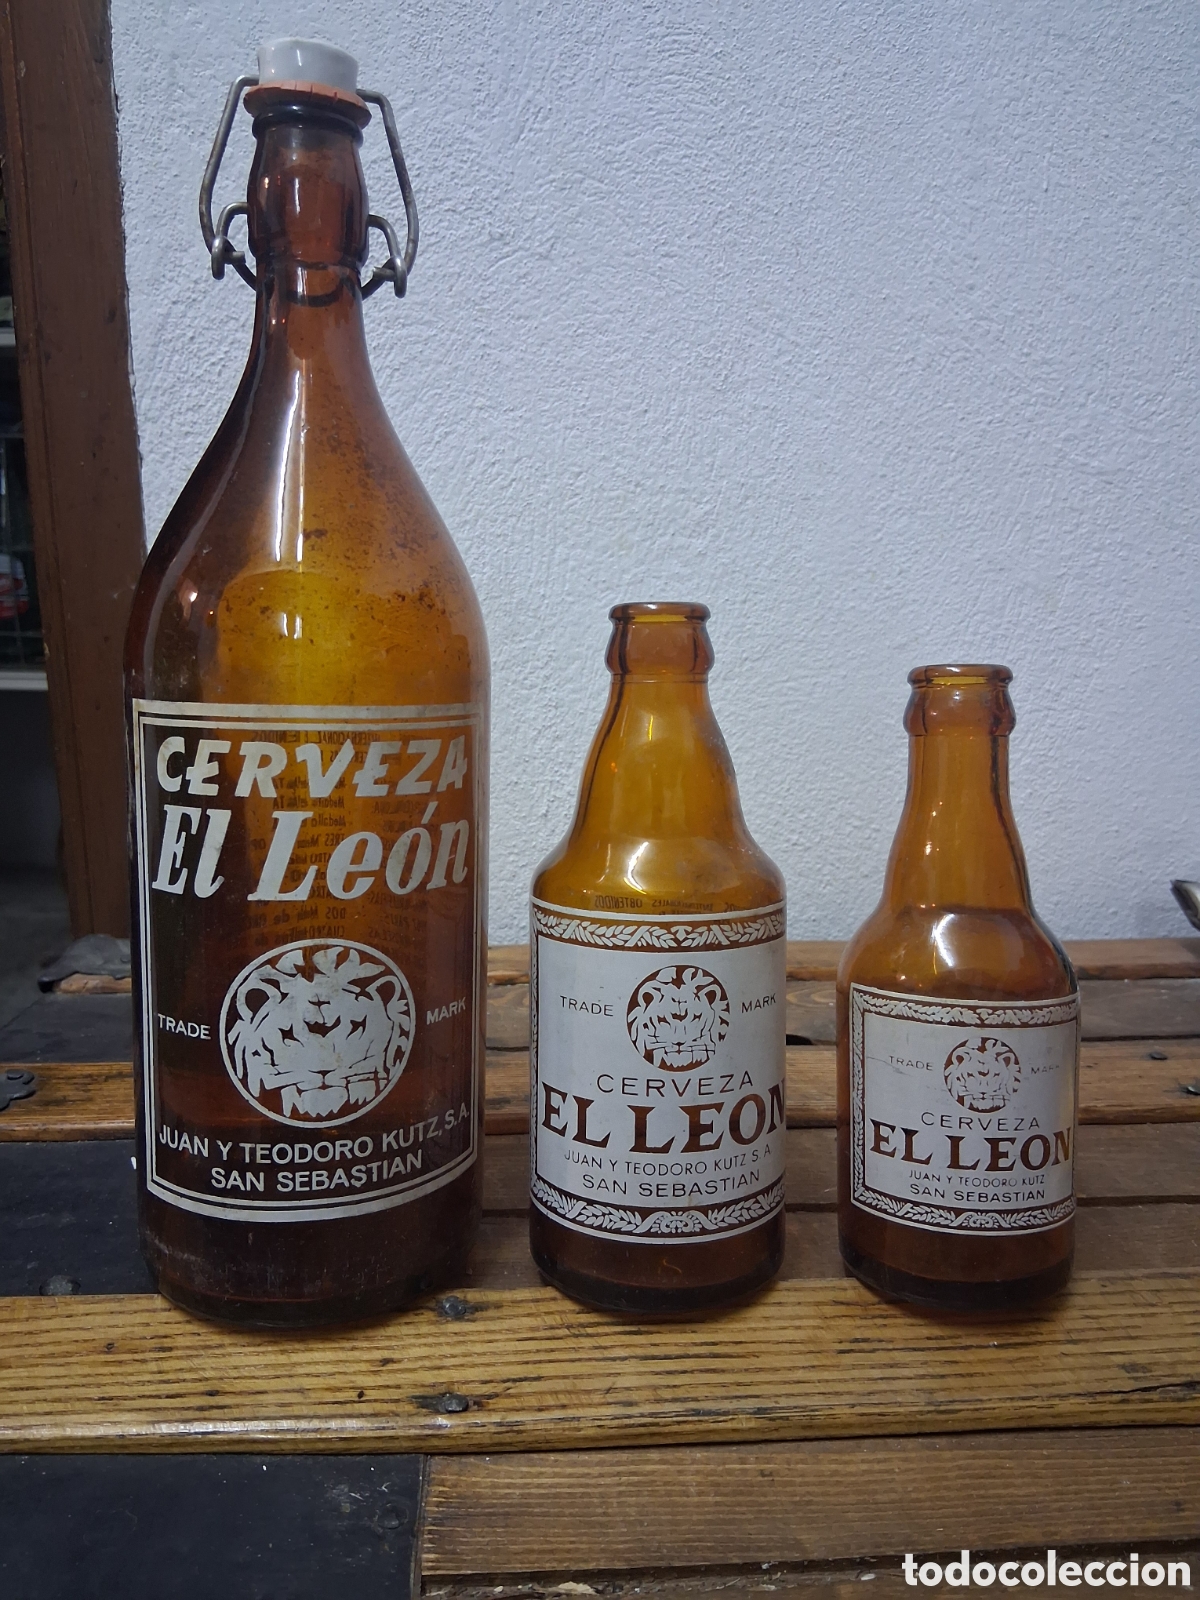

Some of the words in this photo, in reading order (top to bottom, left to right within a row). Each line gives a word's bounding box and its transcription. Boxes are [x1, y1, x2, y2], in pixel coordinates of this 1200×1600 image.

[157, 735, 468, 798] CERVEZA
[151, 804, 232, 898] El
[247, 802, 470, 901] León
[157, 1013, 211, 1041] TRADE
[425, 996, 467, 1026] MARK
[560, 995, 614, 1017] TRADE
[741, 993, 776, 1014] MARK
[888, 1055, 933, 1071] TRADE
[596, 1070, 754, 1098] CERVEZA
[541, 1081, 611, 1149] EL
[626, 1077, 785, 1154] LEON
[920, 1111, 1040, 1131] CERVEZA
[159, 1125, 209, 1158] JUAN
[216, 1140, 233, 1161] Y
[240, 1136, 374, 1165] TEODORO
[869, 1118, 933, 1166] EL
[944, 1126, 1072, 1172] LEON
[211, 1168, 265, 1192] SAN
[276, 1149, 423, 1192] SEBASTIAN
[564, 1149, 602, 1169] JUAN
[609, 1160, 618, 1172] Y
[625, 1161, 707, 1177] TEODORO
[714, 1153, 747, 1172] KUTZ
[582, 1174, 627, 1196] SAN
[639, 1169, 760, 1198] SEBASTIAN
[909, 1169, 941, 1183] JUAN
[946, 1176, 953, 1184] Y
[959, 1176, 1018, 1188] TEODORO
[1022, 1174, 1045, 1185] KUTZ
[910, 1184, 945, 1199] SAN
[953, 1189, 1045, 1203] SEBASTIAN
